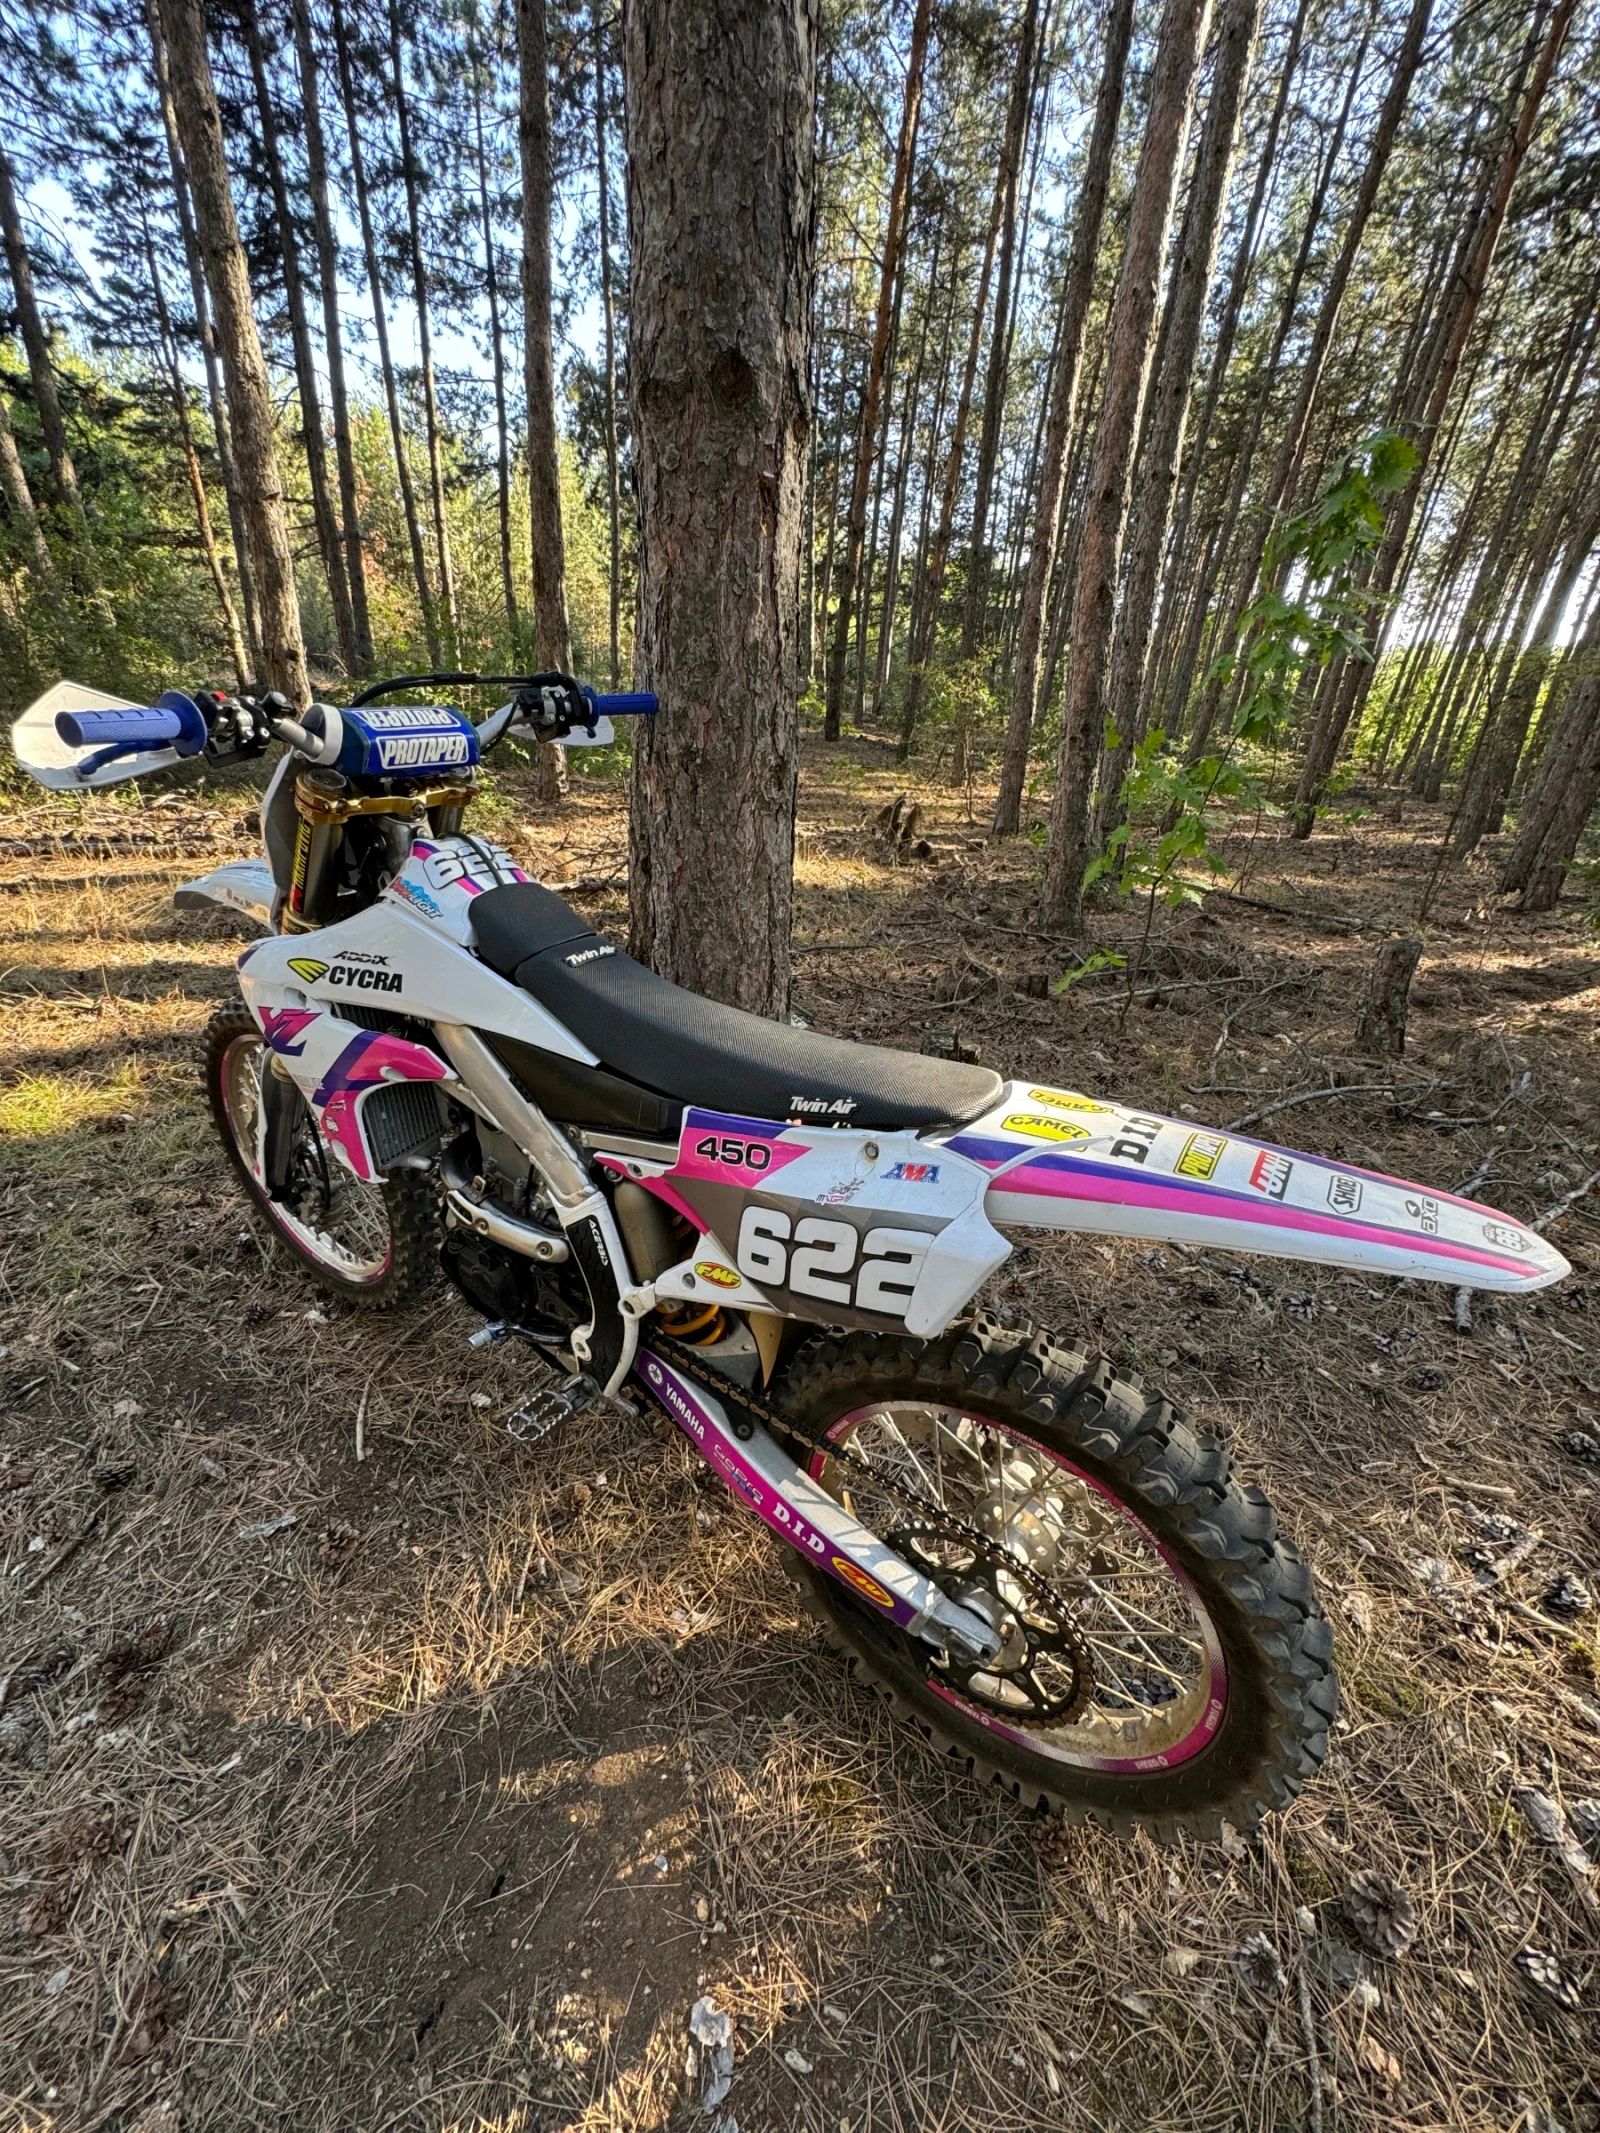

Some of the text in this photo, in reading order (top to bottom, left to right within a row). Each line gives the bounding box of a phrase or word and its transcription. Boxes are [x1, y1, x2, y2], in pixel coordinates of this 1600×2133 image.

[364, 708, 452, 728] PROTAPER
[384, 736, 466, 767] PROTAPER
[565, 945, 616, 965] Twin Air
[328, 965, 403, 994] CYCRA
[790, 1096, 857, 1116] Twin Air
[1009, 1116, 1083, 1139] CAMEL
[696, 1136, 772, 1171] 450
[880, 1161, 941, 1184] AMA
[695, 1262, 741, 1286] FMF
[736, 1204, 937, 1317] 622
[665, 1382, 705, 1440] YAMAHA
[714, 1443, 764, 1501] GoPro
[772, 1501, 826, 1554] D.I.D
